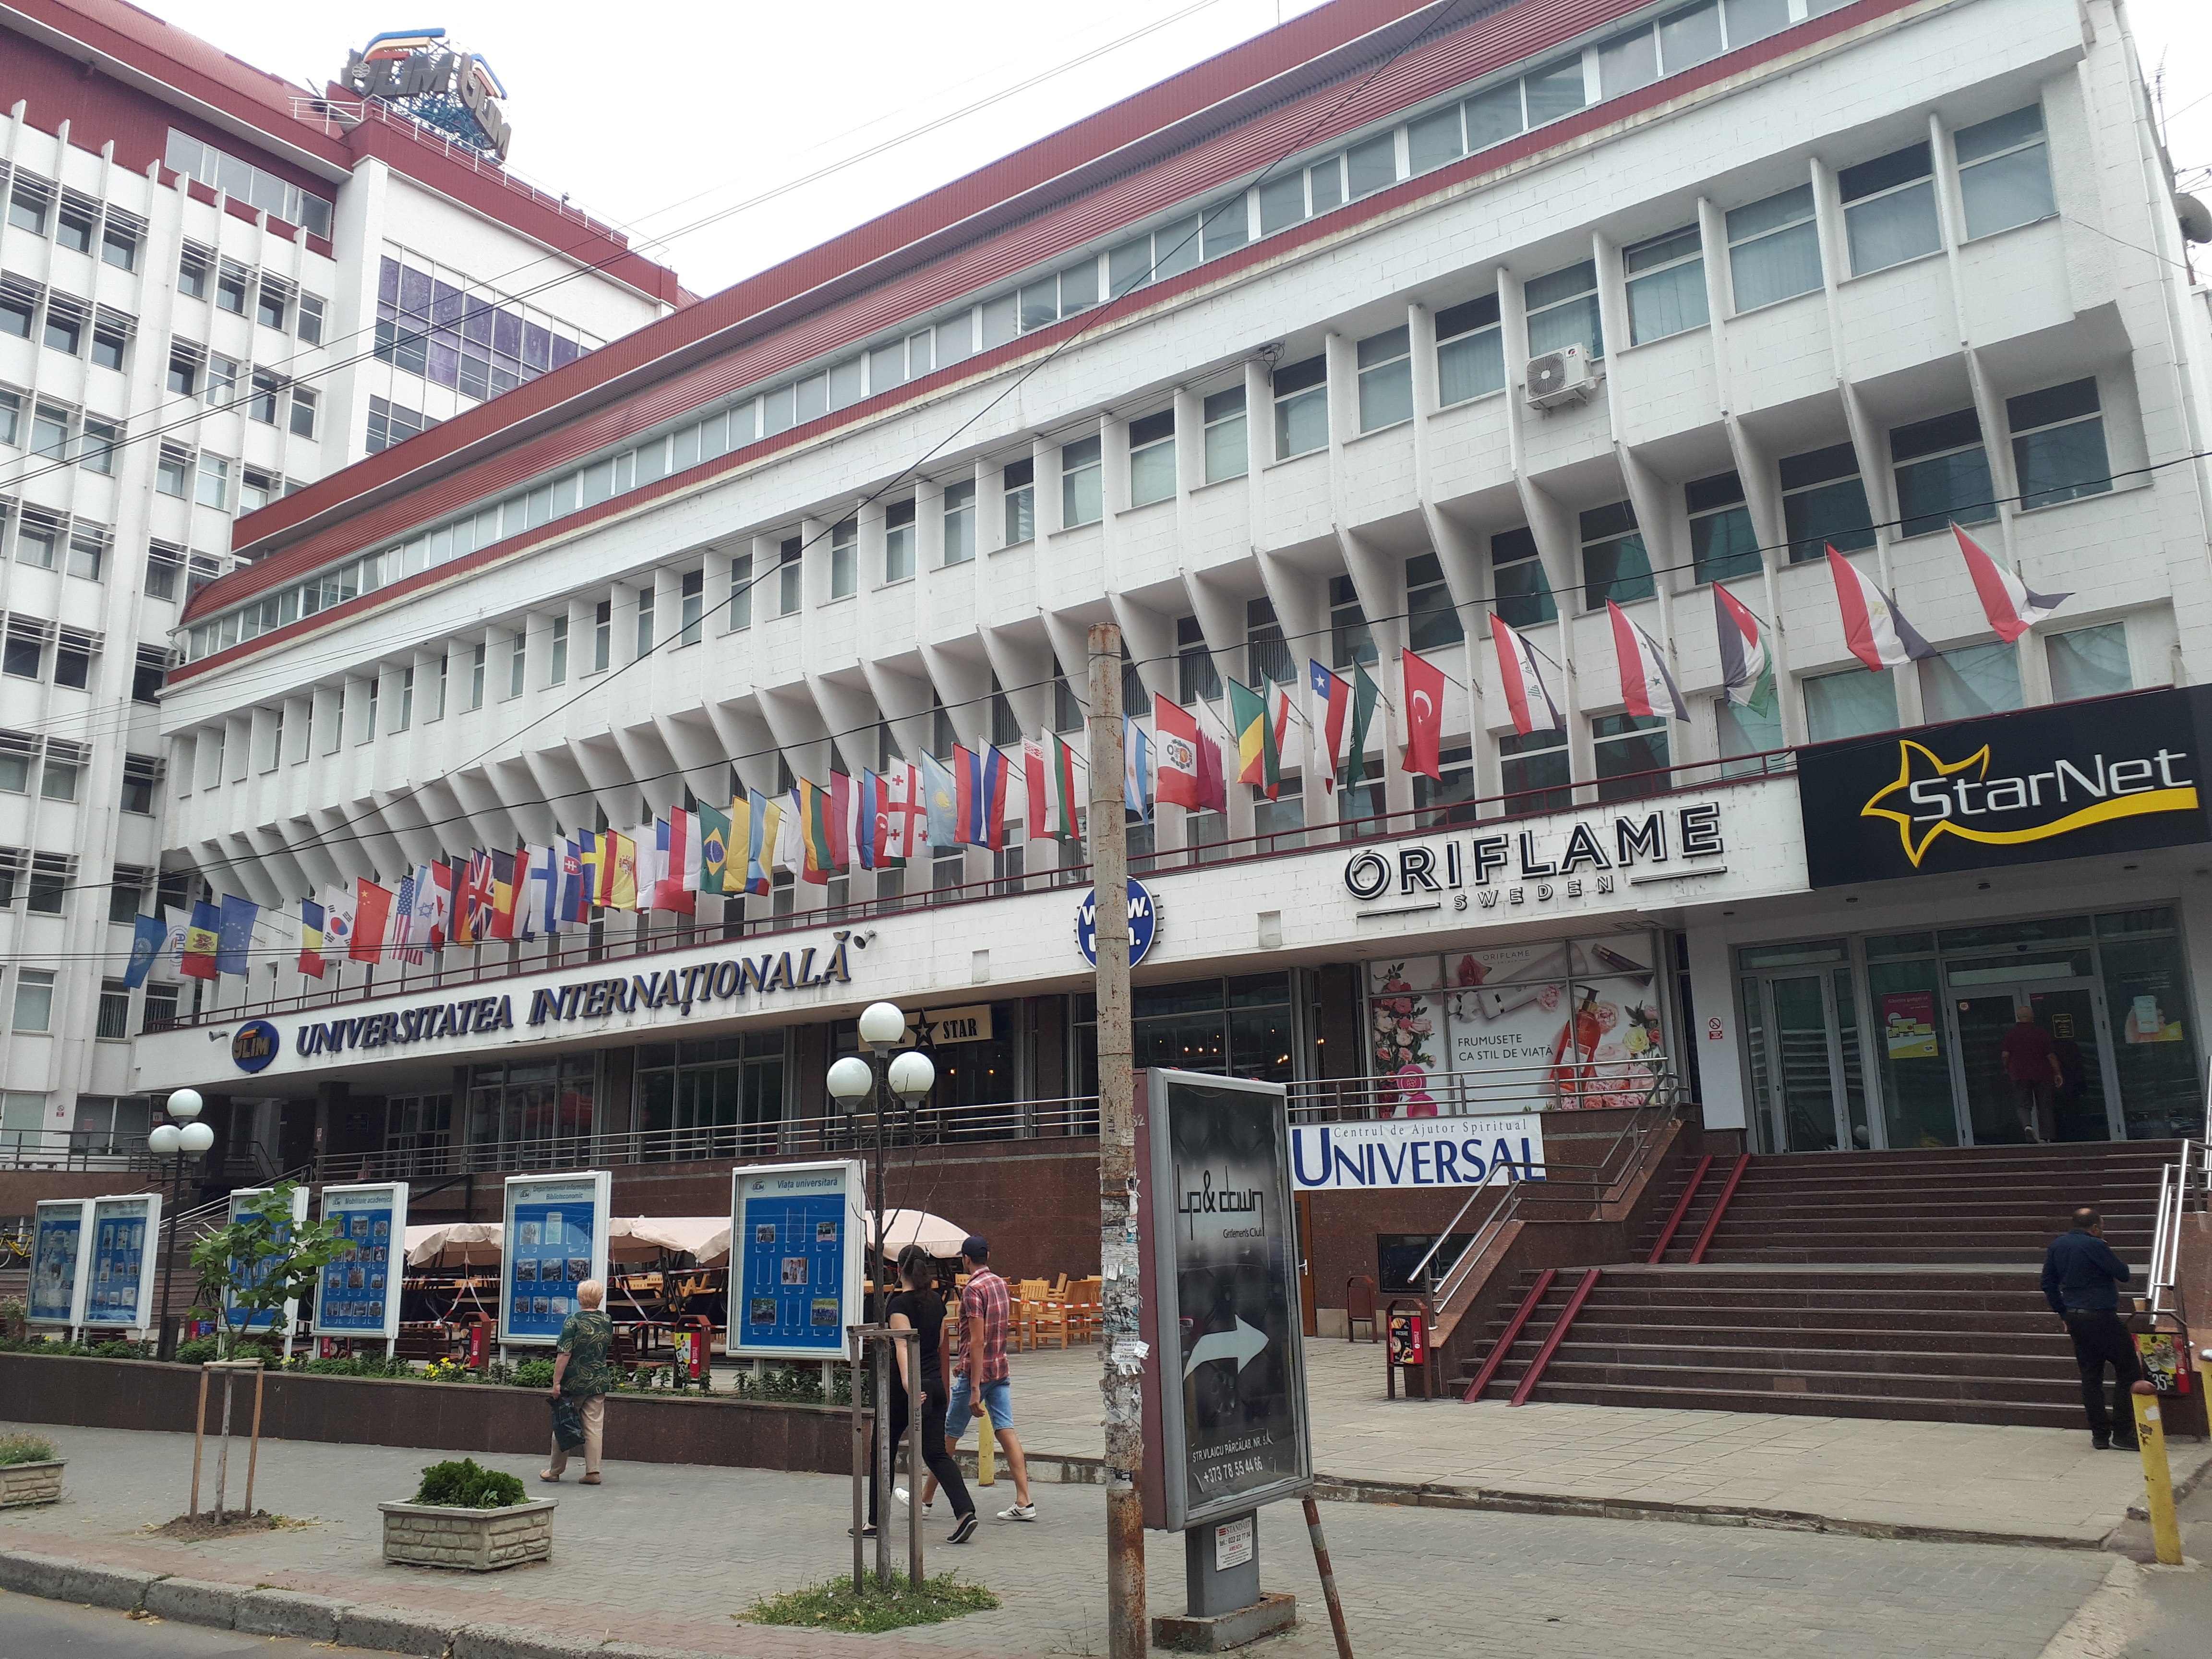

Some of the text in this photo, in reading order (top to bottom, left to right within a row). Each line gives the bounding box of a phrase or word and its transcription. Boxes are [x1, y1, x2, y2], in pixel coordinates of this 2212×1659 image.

[1910, 748, 2194, 821] StarNet
[1344, 801, 1724, 901] ORIFLAME
[1454, 875, 1614, 911] SWEDEN
[1483, 950, 1530, 961] ORIFLAME
[296, 930, 852, 1057] UNIVERSITATEA INTERNAȚIONALĂ
[942, 1018, 978, 1039] STAR
[1458, 1052, 1474, 1061] CA
[1477, 1050, 1500, 1060] STIL
[1503, 1048, 1518, 1058] DE
[1334, 1118, 1527, 1138] Centrul de Ajutor Spiritual
[1292, 1127, 1547, 1188] UNIVERSAL
[1204, 1455, 1263, 1483] +373 78 55 44 66
